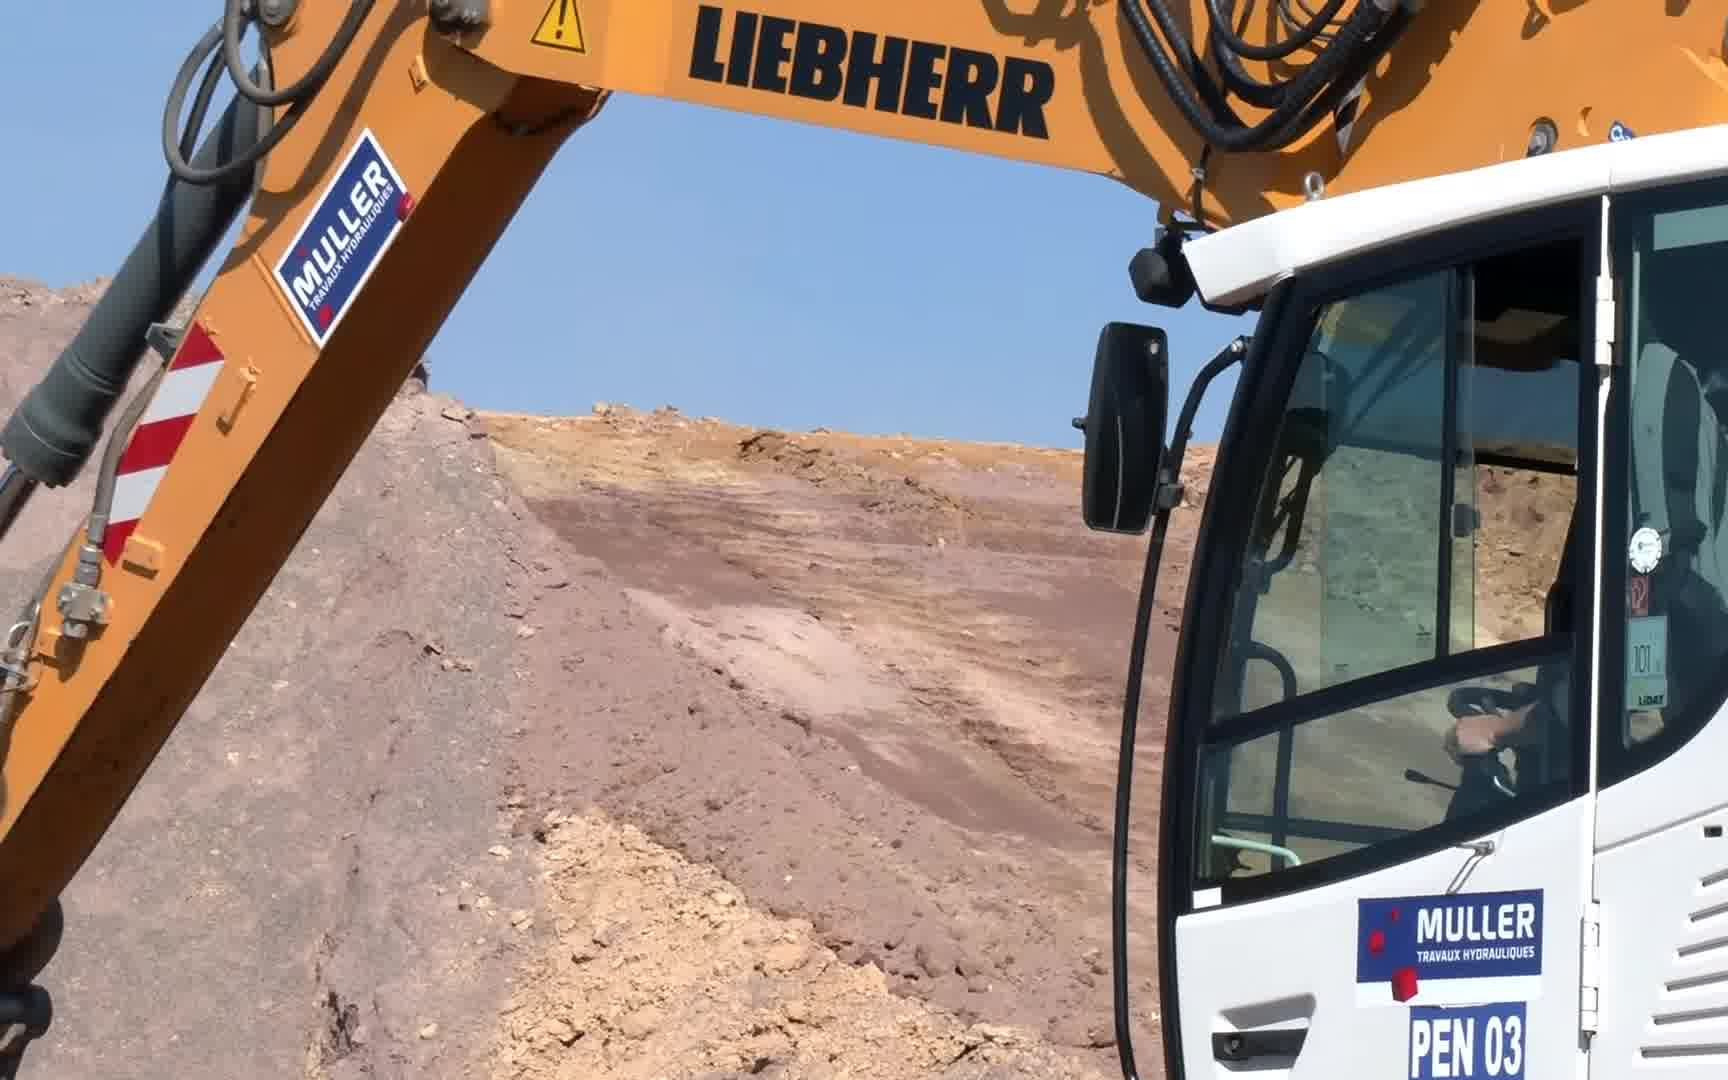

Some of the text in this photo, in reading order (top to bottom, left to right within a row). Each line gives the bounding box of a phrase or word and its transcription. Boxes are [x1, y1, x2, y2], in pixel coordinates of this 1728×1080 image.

[688, 5, 1056, 140] LIEBHERR
[292, 160, 389, 306] MULLER
[309, 183, 394, 311] TRAVAUX HYDRAULIQUES
[1416, 903, 1536, 943] MULLER
[1417, 945, 1535, 963] TRAVAUX HYDRAULIQUES
[1411, 1015, 1522, 1079] PEN 03
